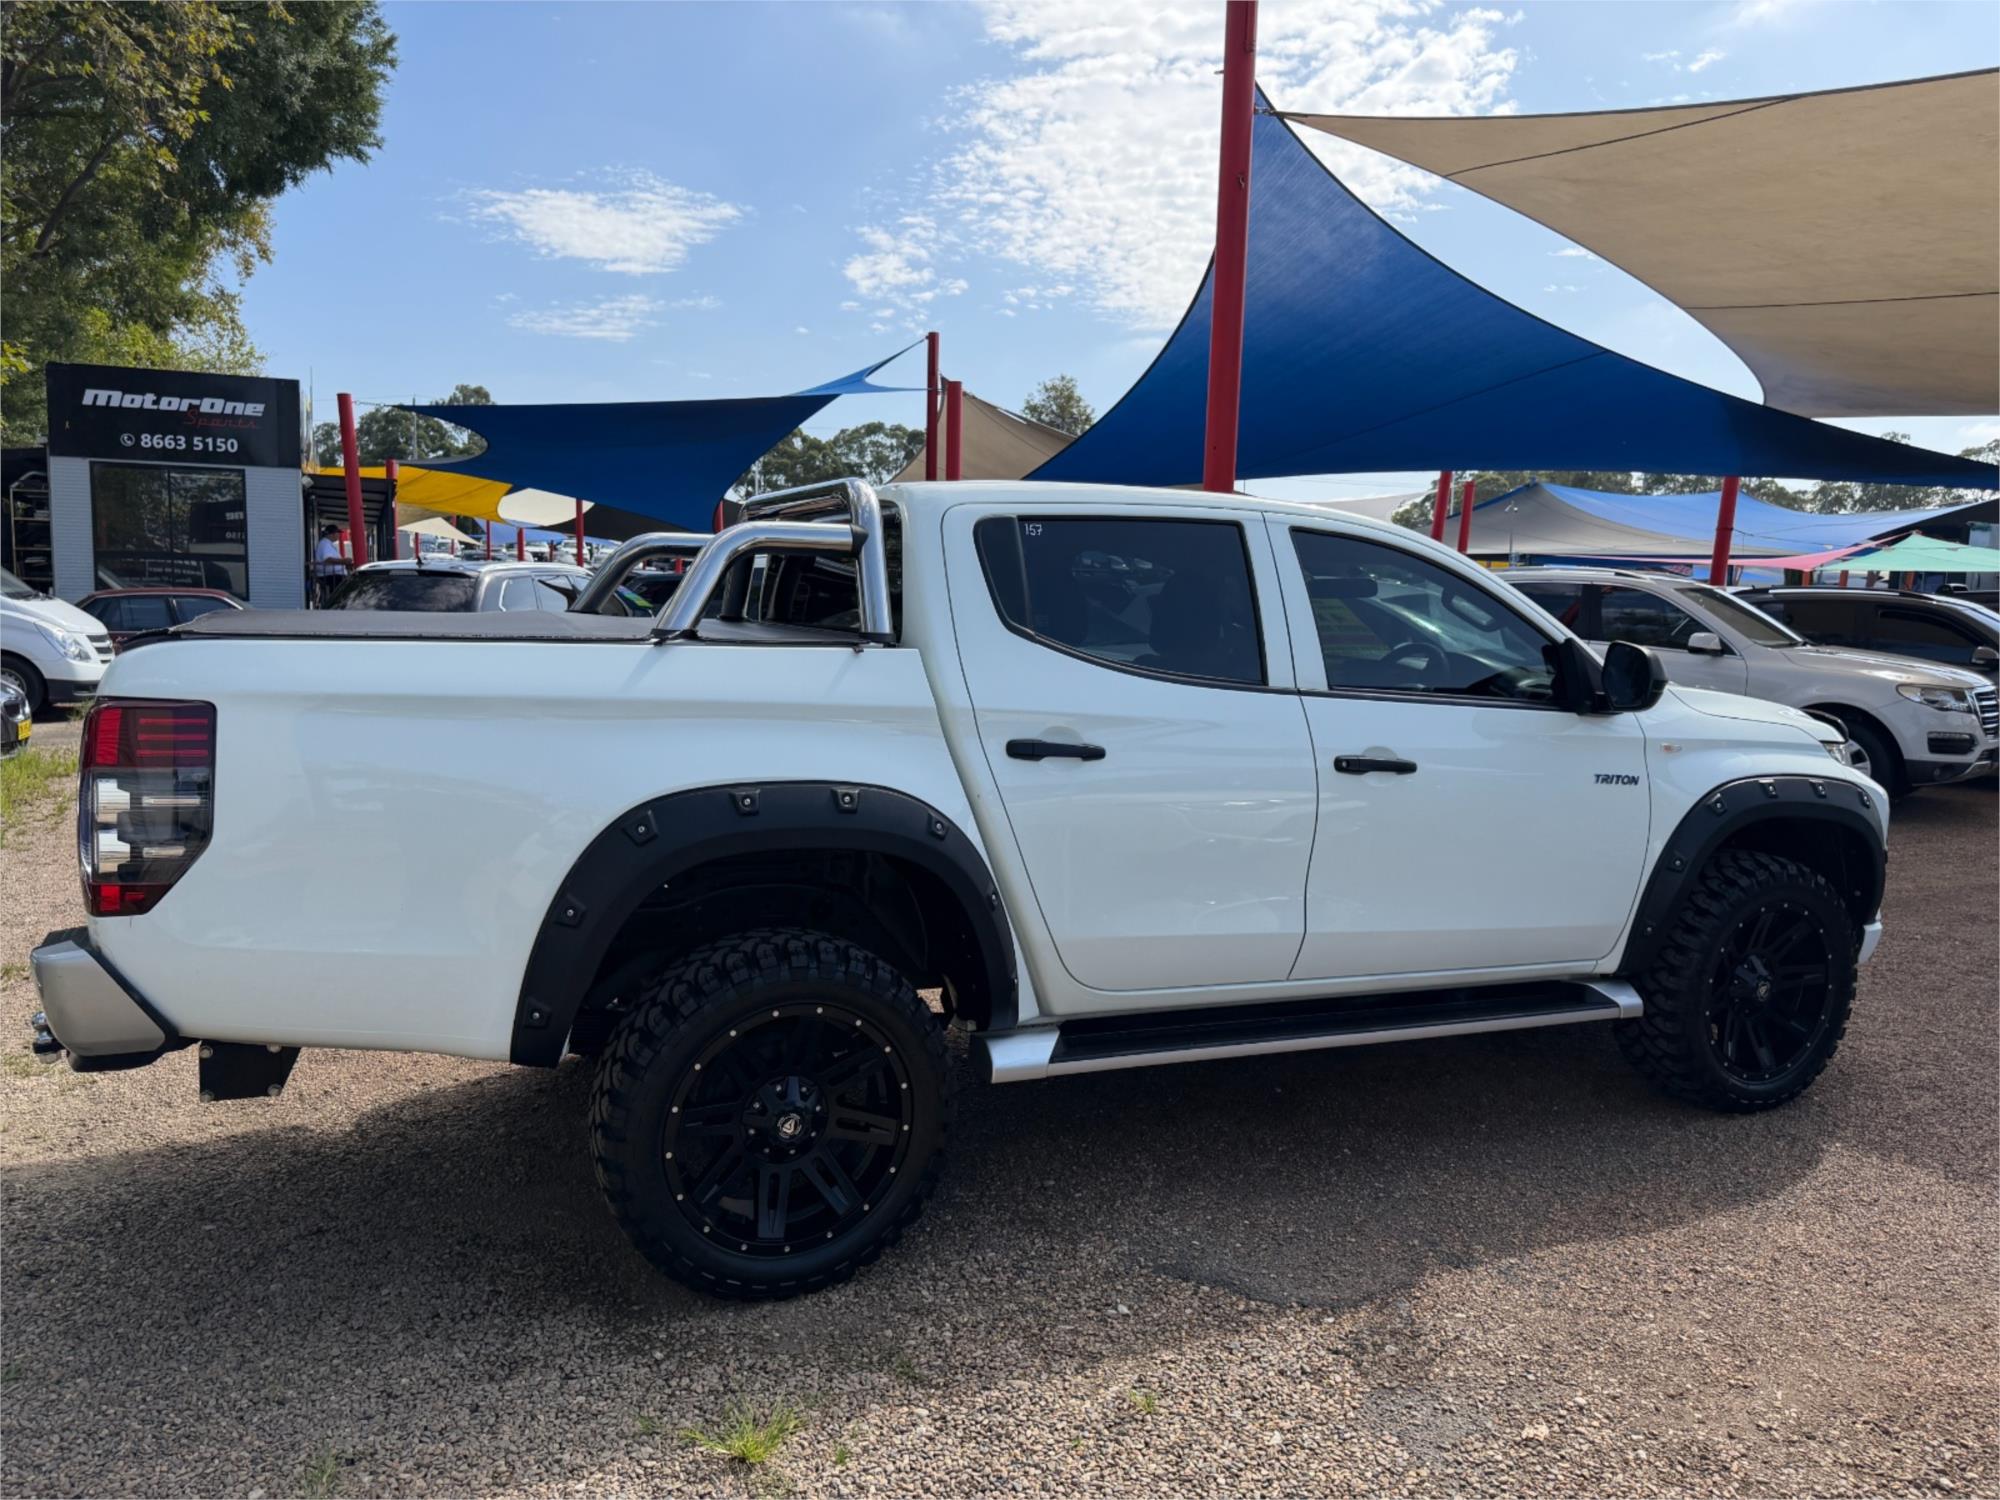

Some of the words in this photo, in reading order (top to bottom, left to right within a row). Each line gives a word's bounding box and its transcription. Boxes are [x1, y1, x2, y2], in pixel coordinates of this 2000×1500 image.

[82, 388, 265, 417] MotorOne
[140, 433, 186, 450] 8663
[193, 436, 238, 453] 5150
[1024, 523, 1043, 536] 157
[1593, 774, 1640, 786] TRITON
